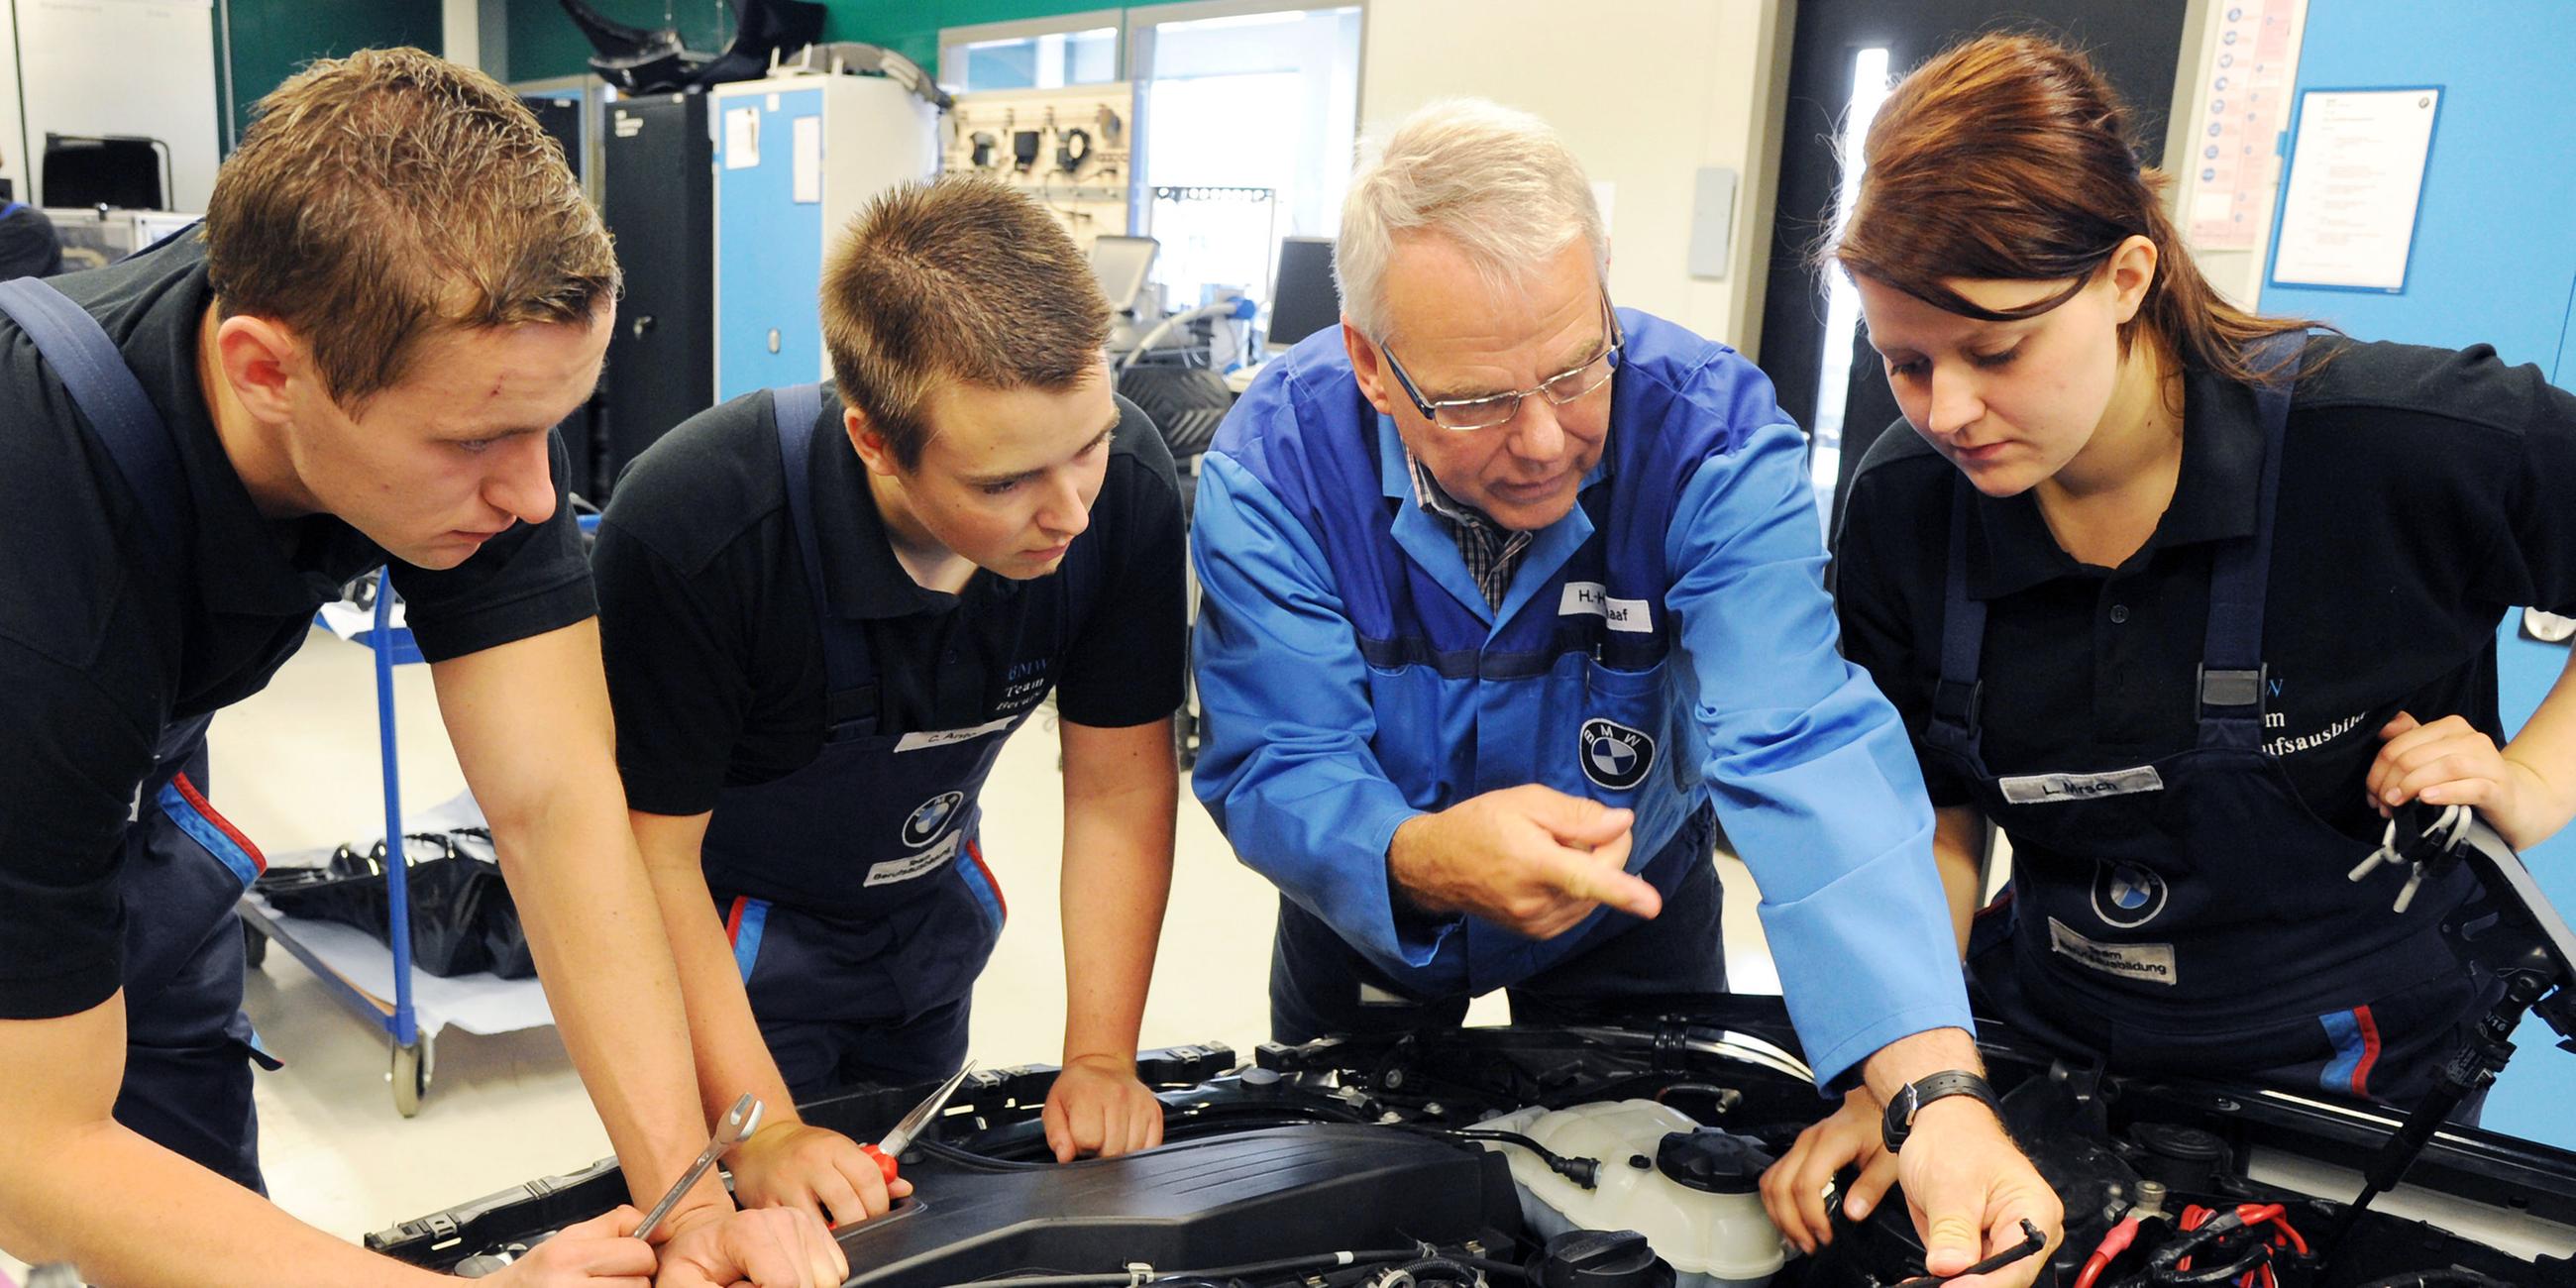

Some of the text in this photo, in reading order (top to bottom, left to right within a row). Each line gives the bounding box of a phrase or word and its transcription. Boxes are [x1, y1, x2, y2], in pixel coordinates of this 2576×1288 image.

[1606, 607, 1628, 622] aaf
[1005, 678, 1044, 698] Team
[1584, 724, 1642, 746] BMW
